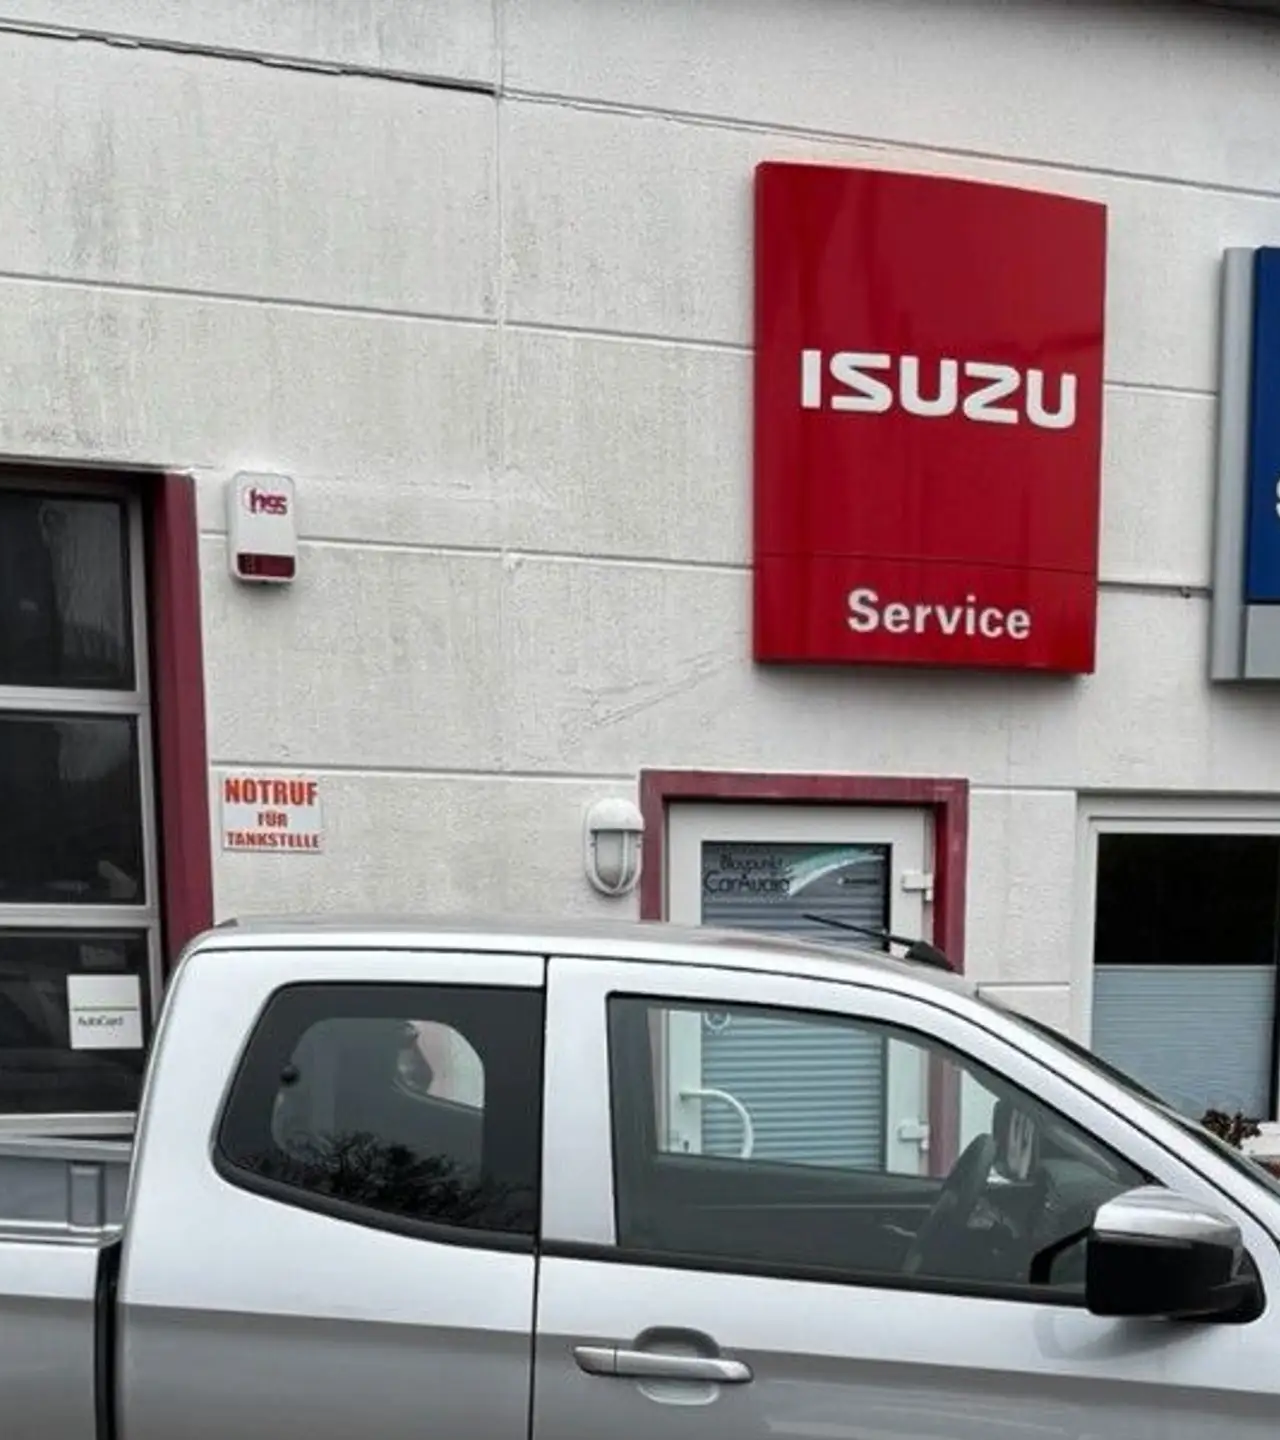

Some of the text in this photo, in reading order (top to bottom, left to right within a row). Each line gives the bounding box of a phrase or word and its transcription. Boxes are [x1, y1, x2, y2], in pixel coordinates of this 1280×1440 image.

[800, 348, 1078, 430] ISUZU
[847, 587, 1031, 641] Service
[224, 777, 318, 807] NOTRUF
[257, 808, 288, 828] FÜR
[226, 831, 320, 849] TANKSTELLE
